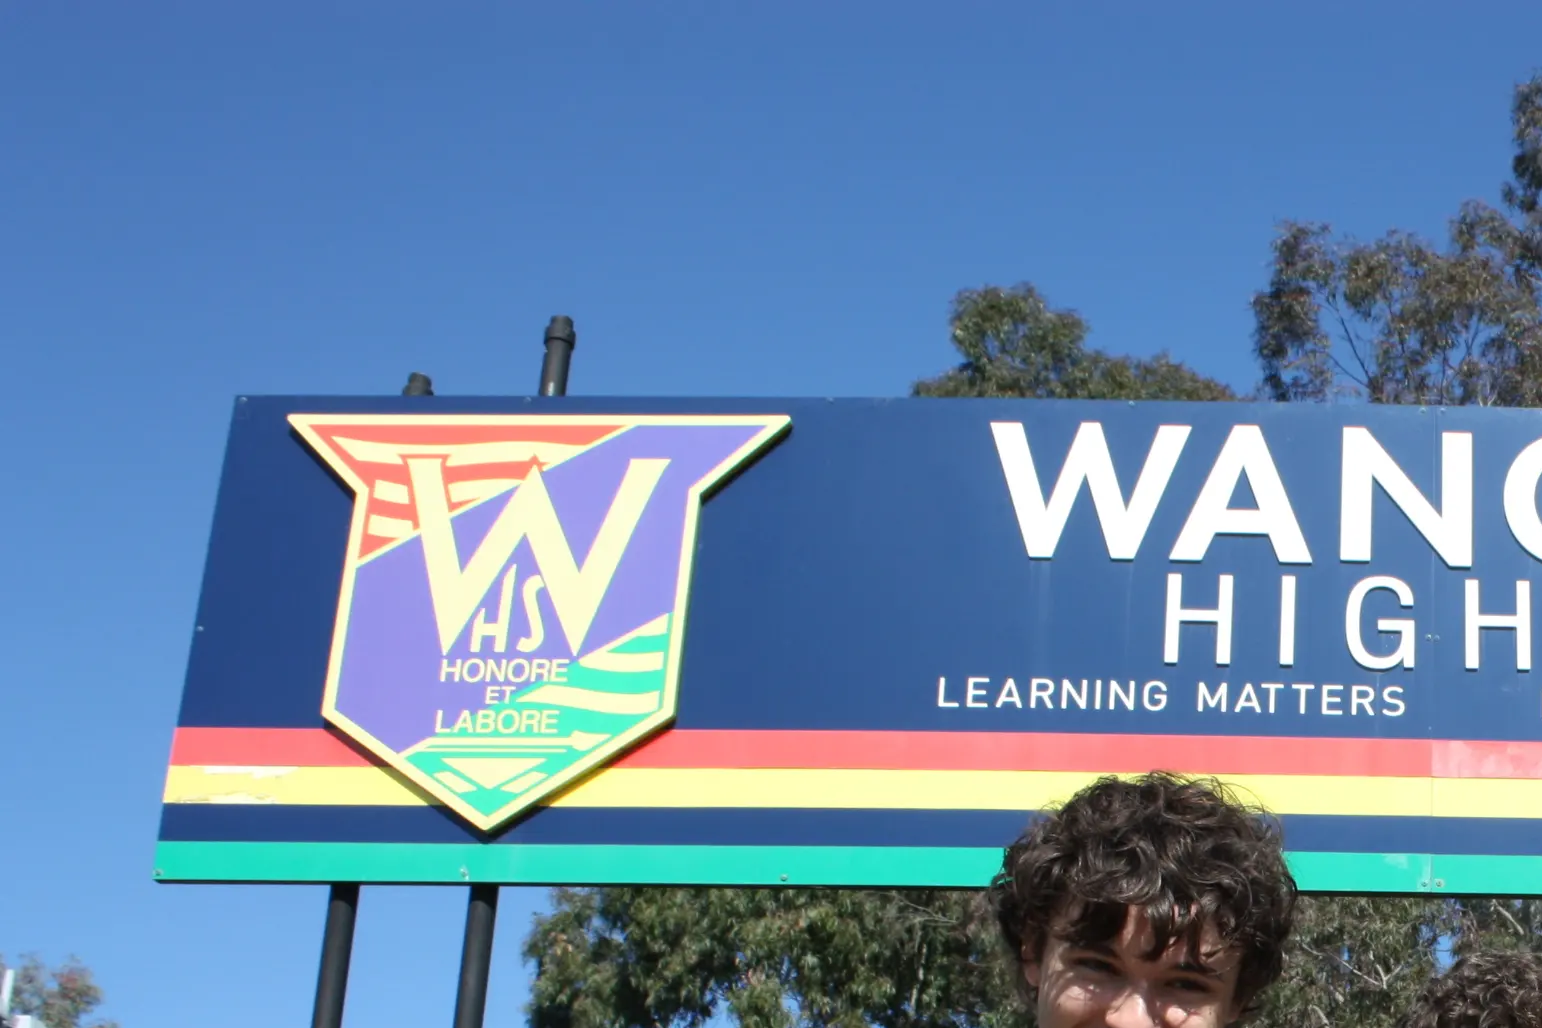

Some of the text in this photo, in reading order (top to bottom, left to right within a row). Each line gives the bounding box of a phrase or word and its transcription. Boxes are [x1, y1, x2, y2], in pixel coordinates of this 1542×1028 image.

[1163, 573, 1532, 672] HIGH
[439, 658, 570, 683] HONORE
[485, 686, 516, 705] ET
[937, 677, 1406, 717] LEARNING MATTERS
[434, 709, 560, 734] LABORE
